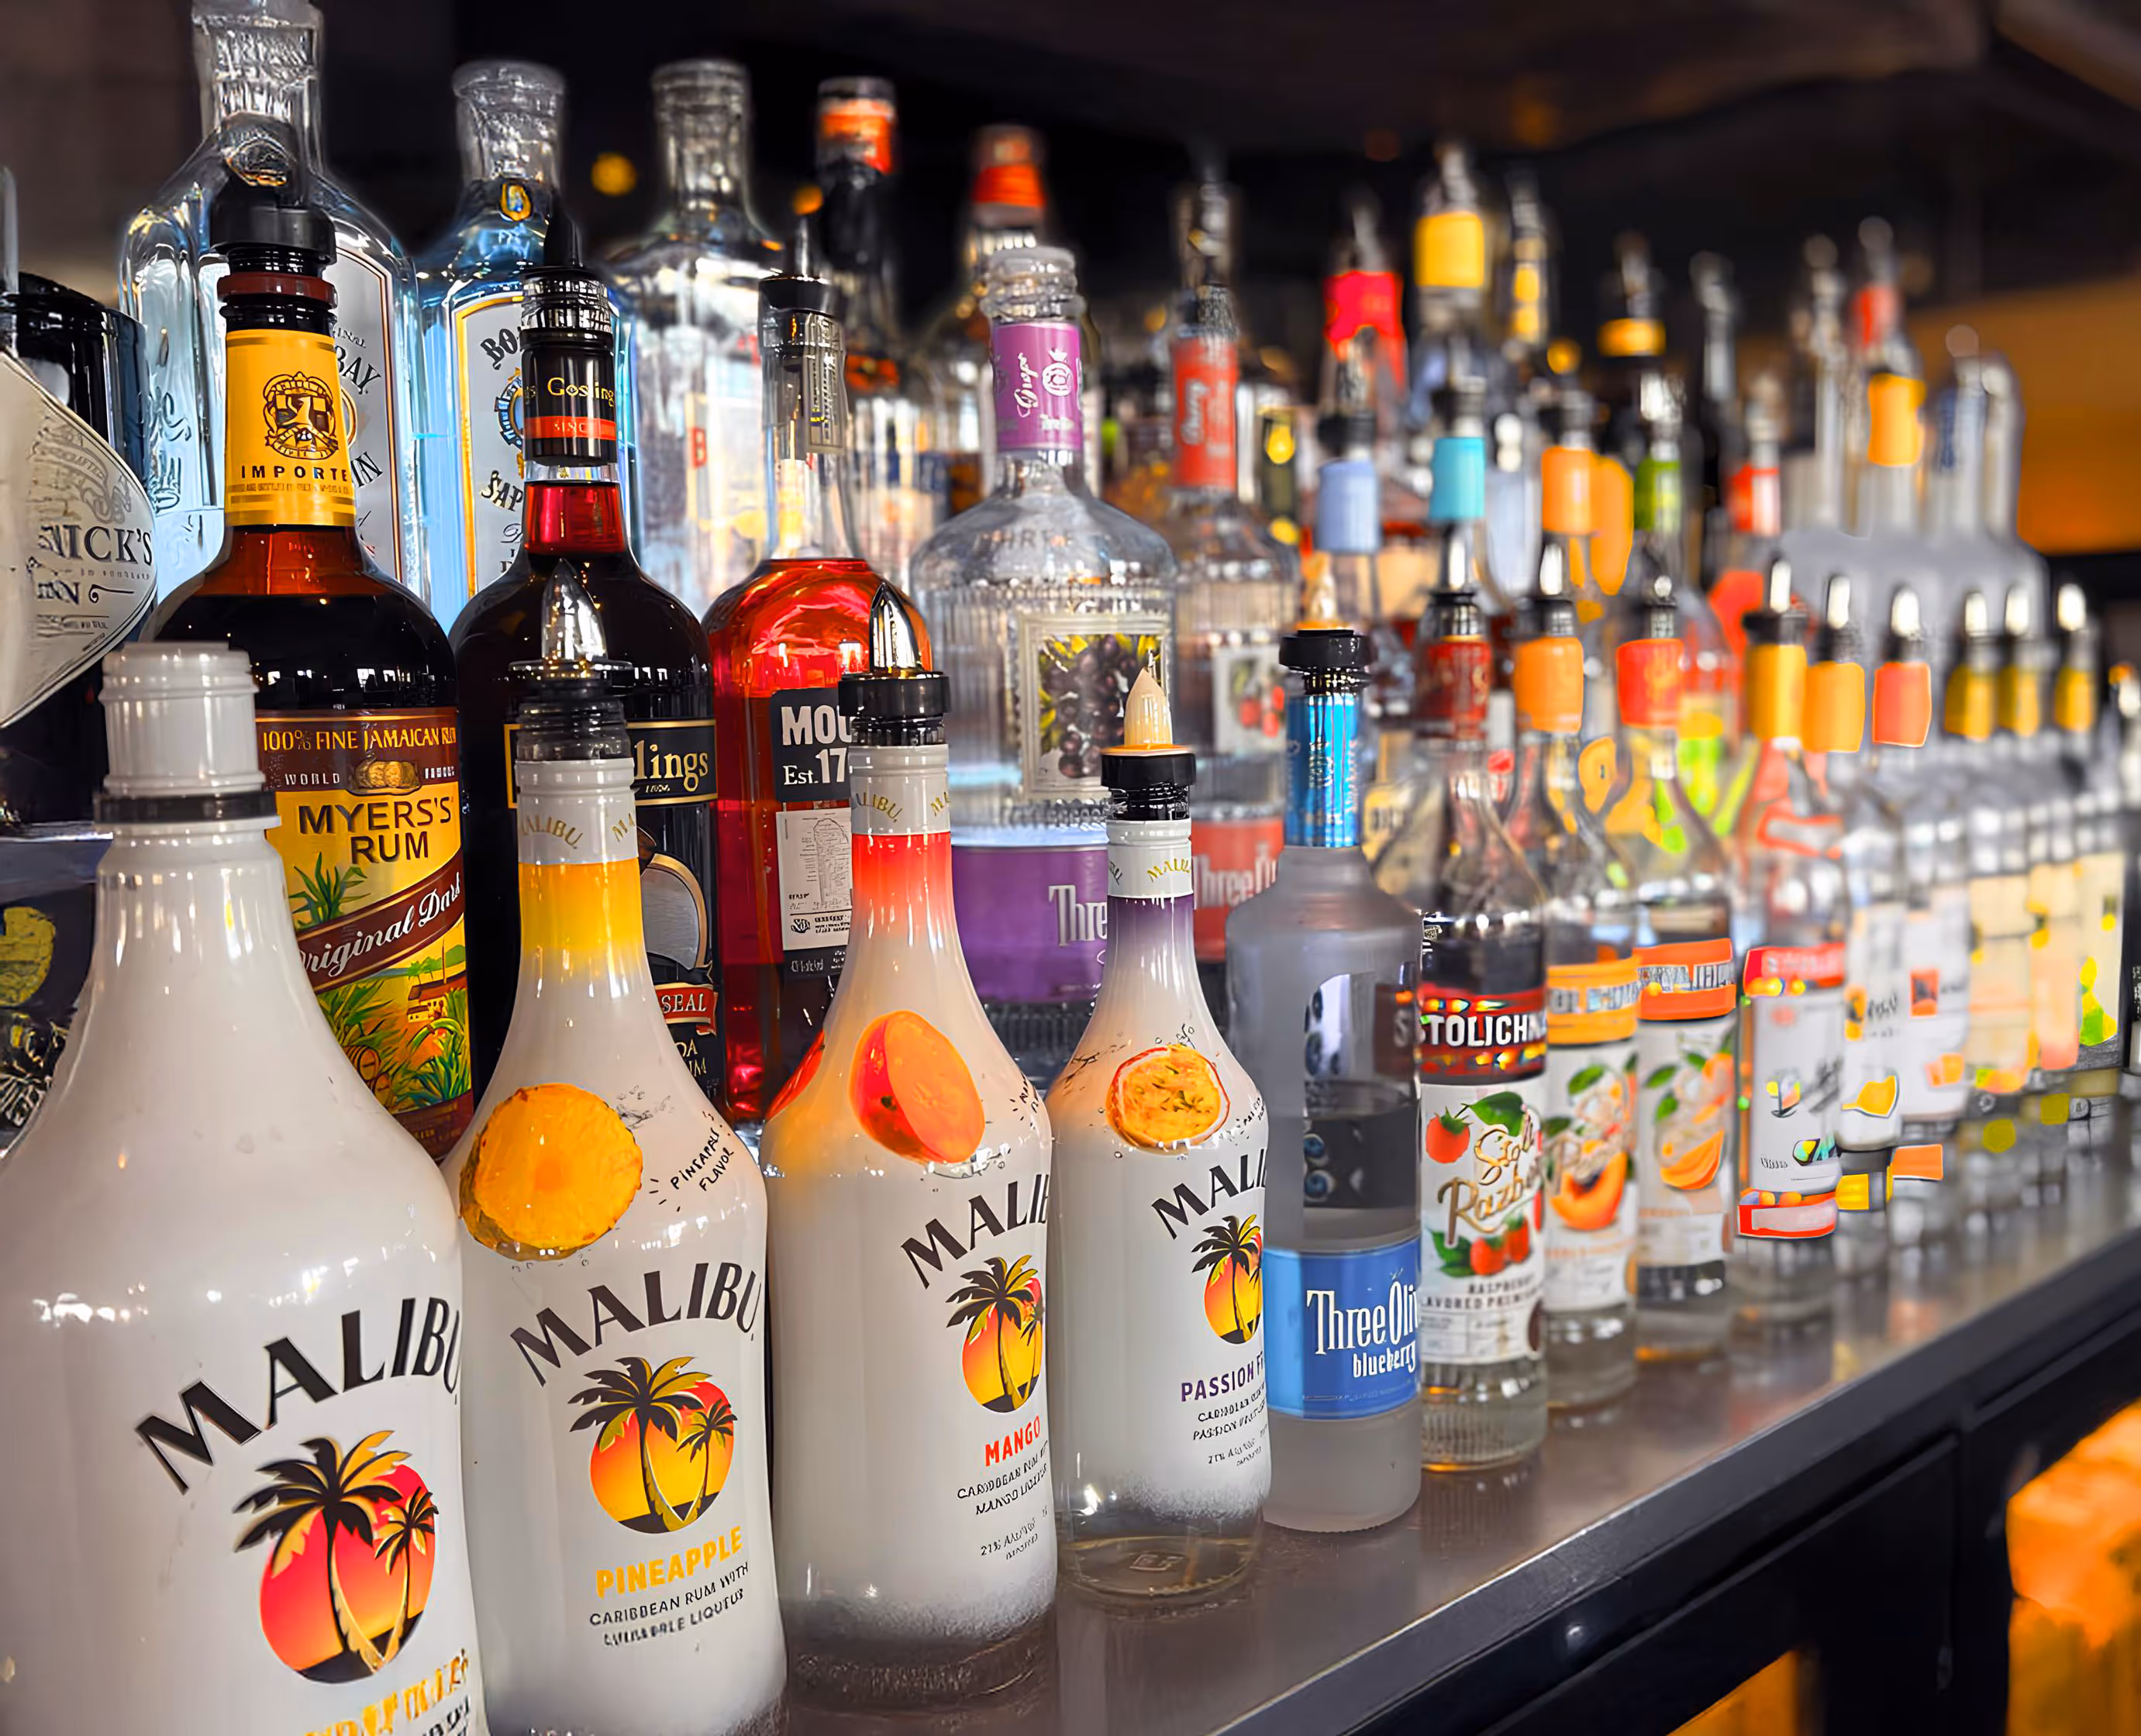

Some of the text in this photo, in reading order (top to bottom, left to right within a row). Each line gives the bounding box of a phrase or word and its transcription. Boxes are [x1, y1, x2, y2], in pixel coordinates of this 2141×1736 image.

[240, 465, 347, 482] IMPORTE
[263, 729, 311, 751] 100%
[316, 730, 358, 751] FINE
[364, 726, 440, 752] JAMAICAN
[284, 771, 341, 787] WORLD
[783, 764, 820, 786] Est.
[298, 796, 452, 835] MYERS'S
[350, 831, 429, 864] RUM
[661, 993, 706, 1014] SEAL
[510, 1262, 761, 1388] MALIBU
[1306, 1290, 1387, 1355] Three
[1353, 1338, 1416, 1378] blueberry
[1181, 1359, 1254, 1402] PASSION
[984, 1415, 1041, 1467] MANGO
[595, 1525, 743, 1600] PINEAPPLE
